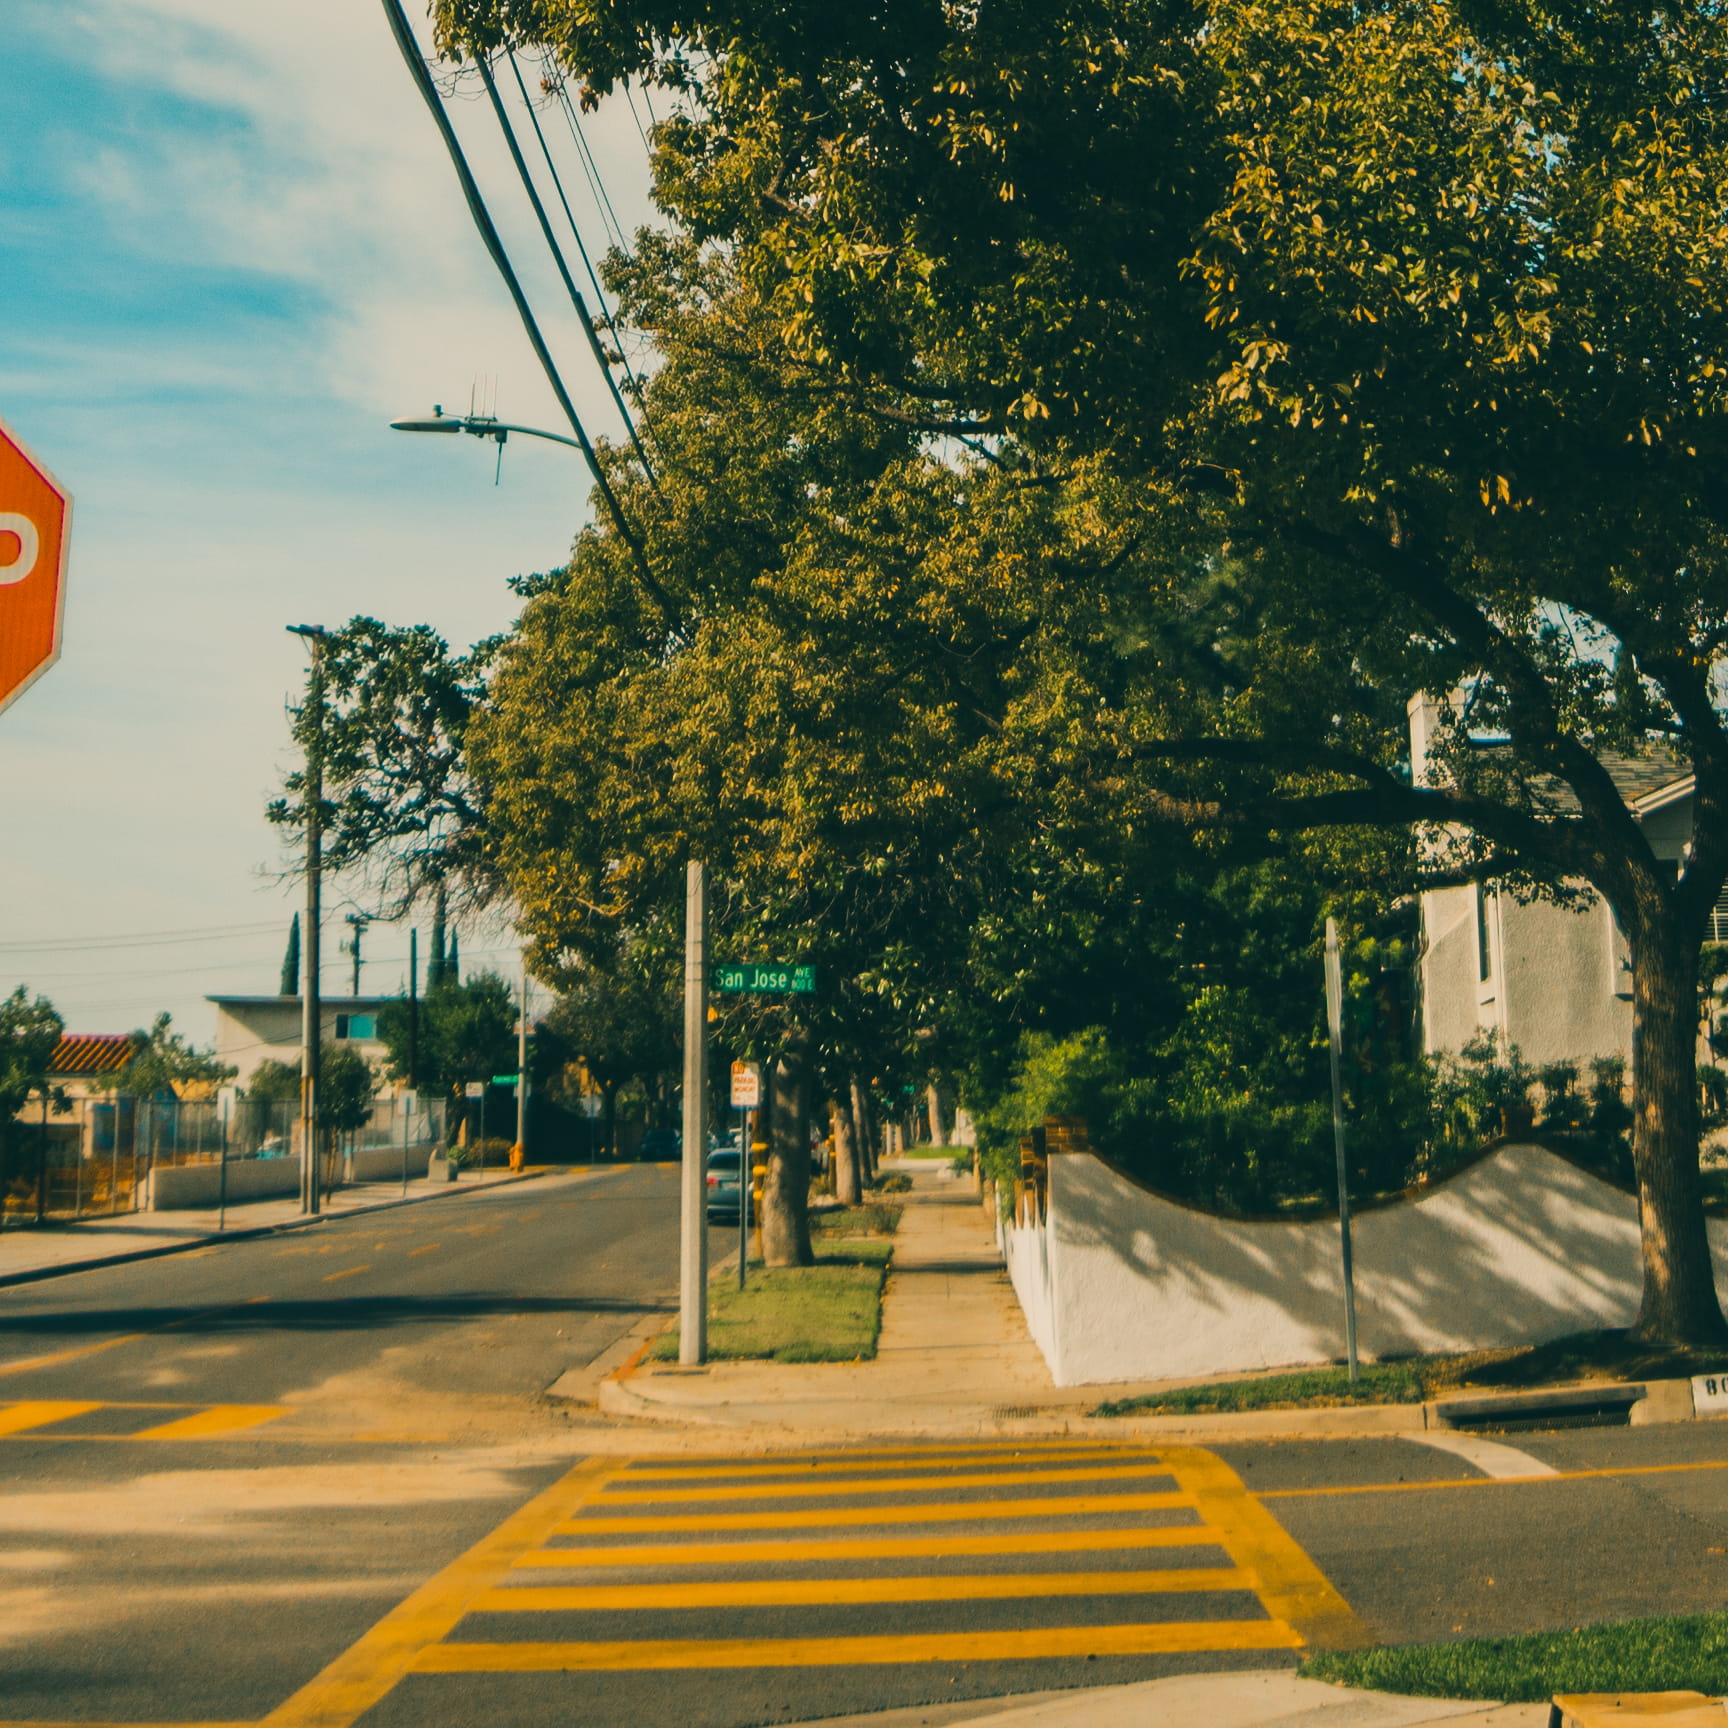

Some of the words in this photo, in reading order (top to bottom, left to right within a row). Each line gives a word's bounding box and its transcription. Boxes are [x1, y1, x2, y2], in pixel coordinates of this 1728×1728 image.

[715, 968, 743, 988] San
[750, 968, 787, 988] Jose
[794, 967, 811, 978] AVE
